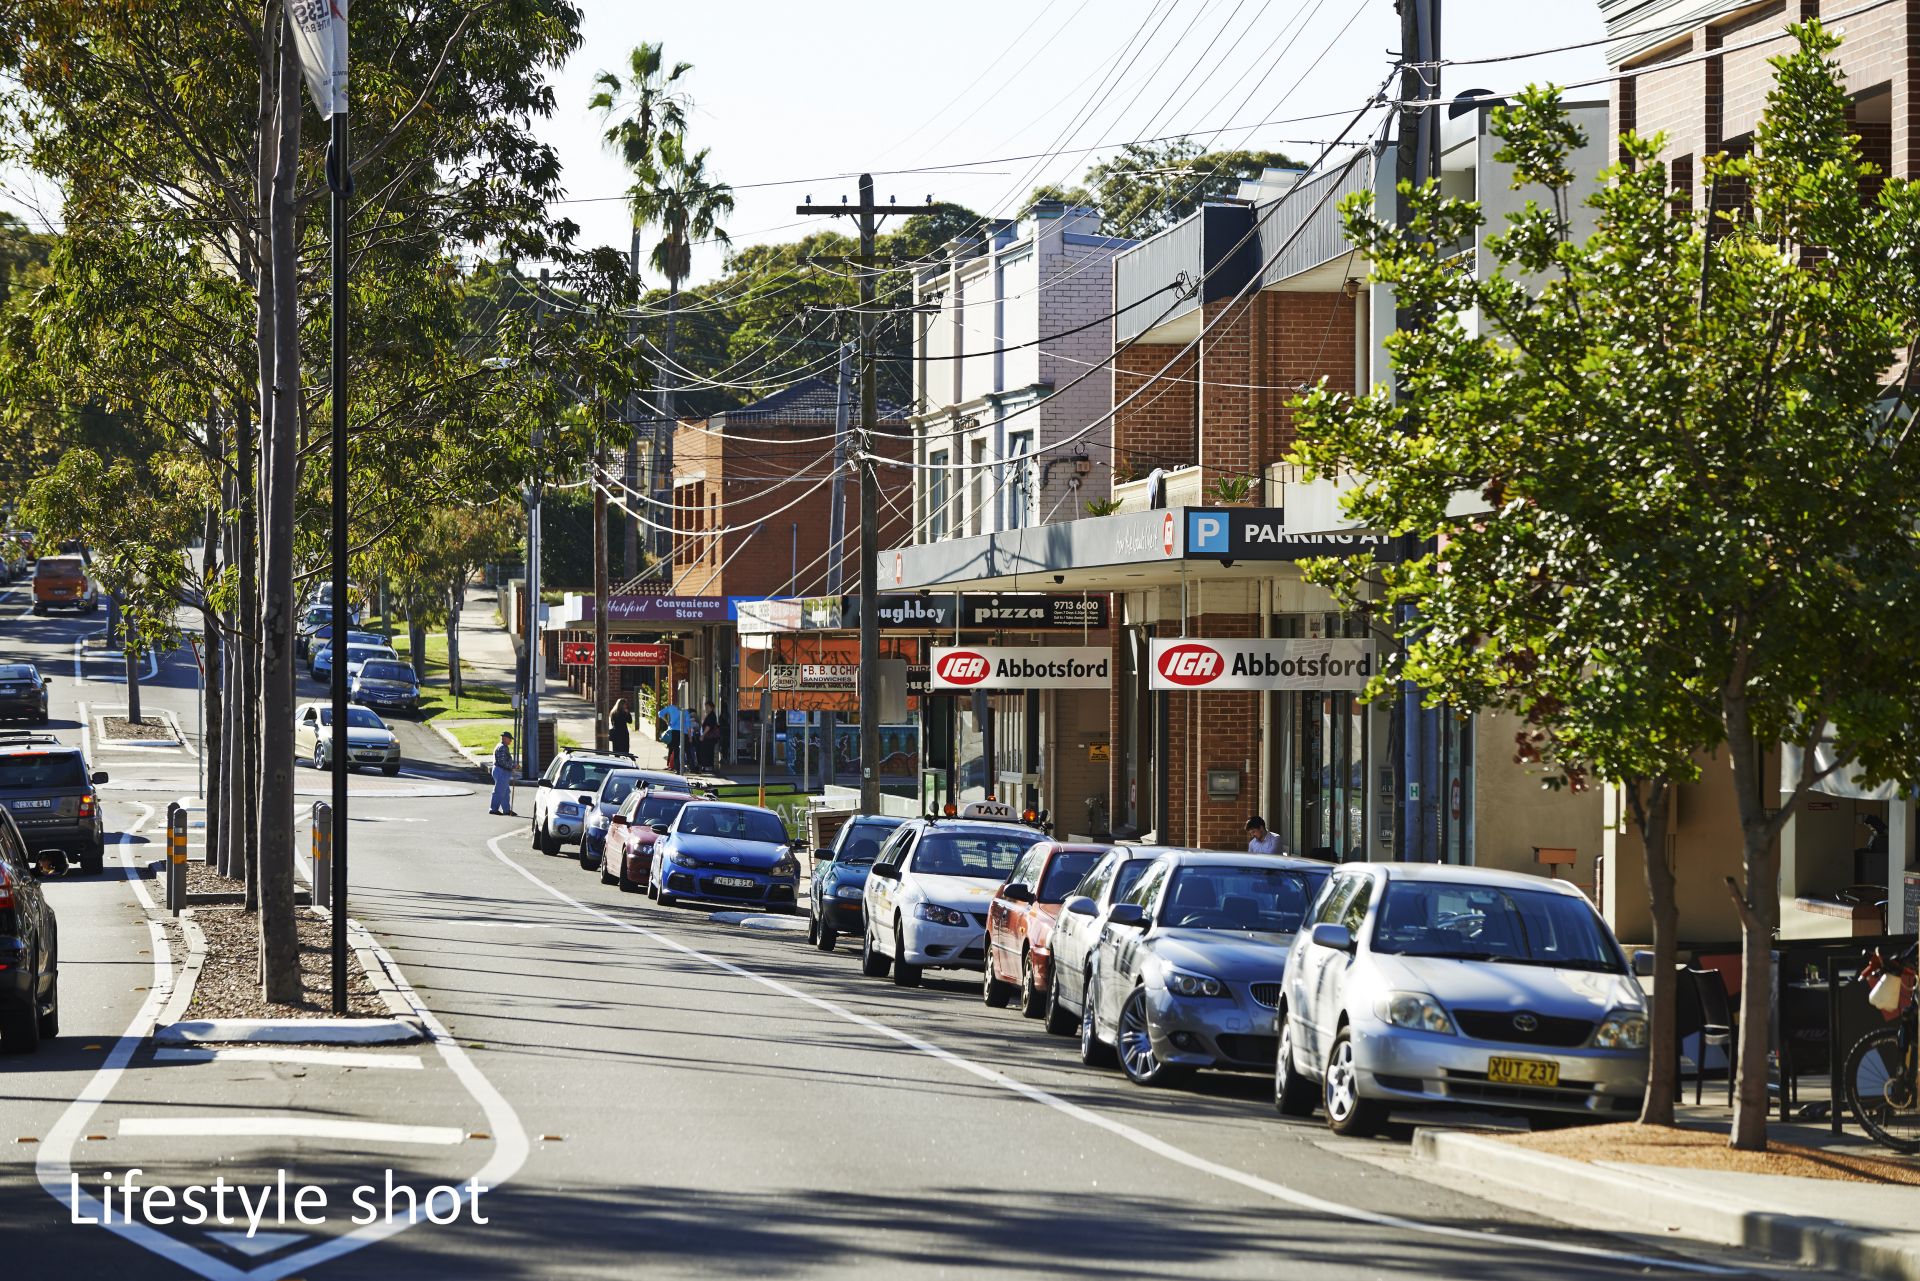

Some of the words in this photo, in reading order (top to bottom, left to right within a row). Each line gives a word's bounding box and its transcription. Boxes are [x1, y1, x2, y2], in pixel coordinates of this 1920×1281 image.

[1197, 518, 1220, 547] P
[592, 600, 648, 617] bbotsford
[655, 599, 720, 608] Convenience
[859, 600, 946, 623] ughboy
[974, 599, 1045, 623] pizza
[1054, 601, 1074, 610] 9713
[1075, 601, 1098, 610] 6600
[675, 609, 704, 618] Store
[620, 650, 658, 658] Abbotsford
[942, 657, 985, 678] IGA
[995, 658, 1108, 678] Abbotsford
[1164, 652, 1219, 677] IGA
[1231, 652, 1371, 677] Abbotsford
[773, 666, 800, 677] ZEST
[1410, 785, 1419, 798] H
[975, 804, 1009, 816] TAXI
